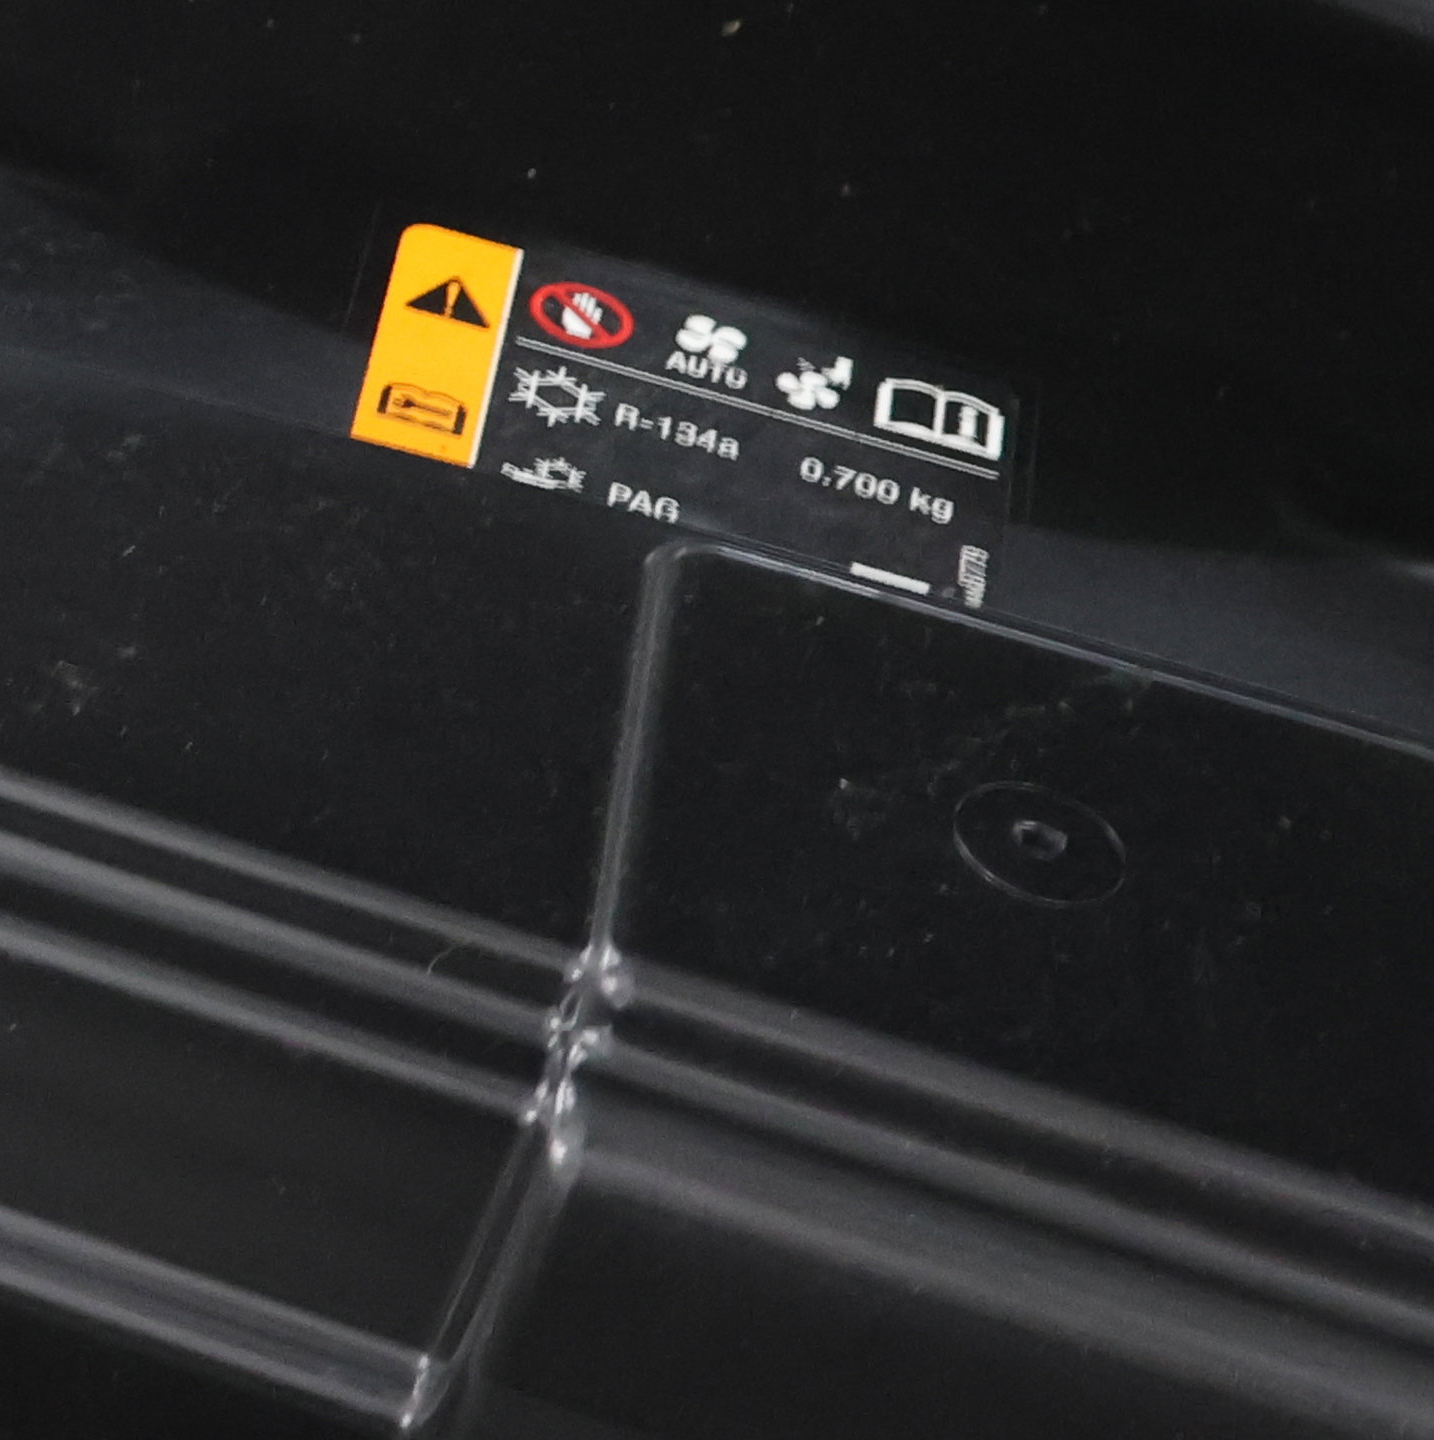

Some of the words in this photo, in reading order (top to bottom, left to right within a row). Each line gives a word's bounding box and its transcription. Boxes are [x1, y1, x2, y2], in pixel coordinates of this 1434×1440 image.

[665, 350, 748, 390] AUTO
[613, 403, 740, 461] R-134a
[800, 456, 901, 506] 0.700
[908, 485, 955, 525] kg
[606, 481, 682, 524] PAG
